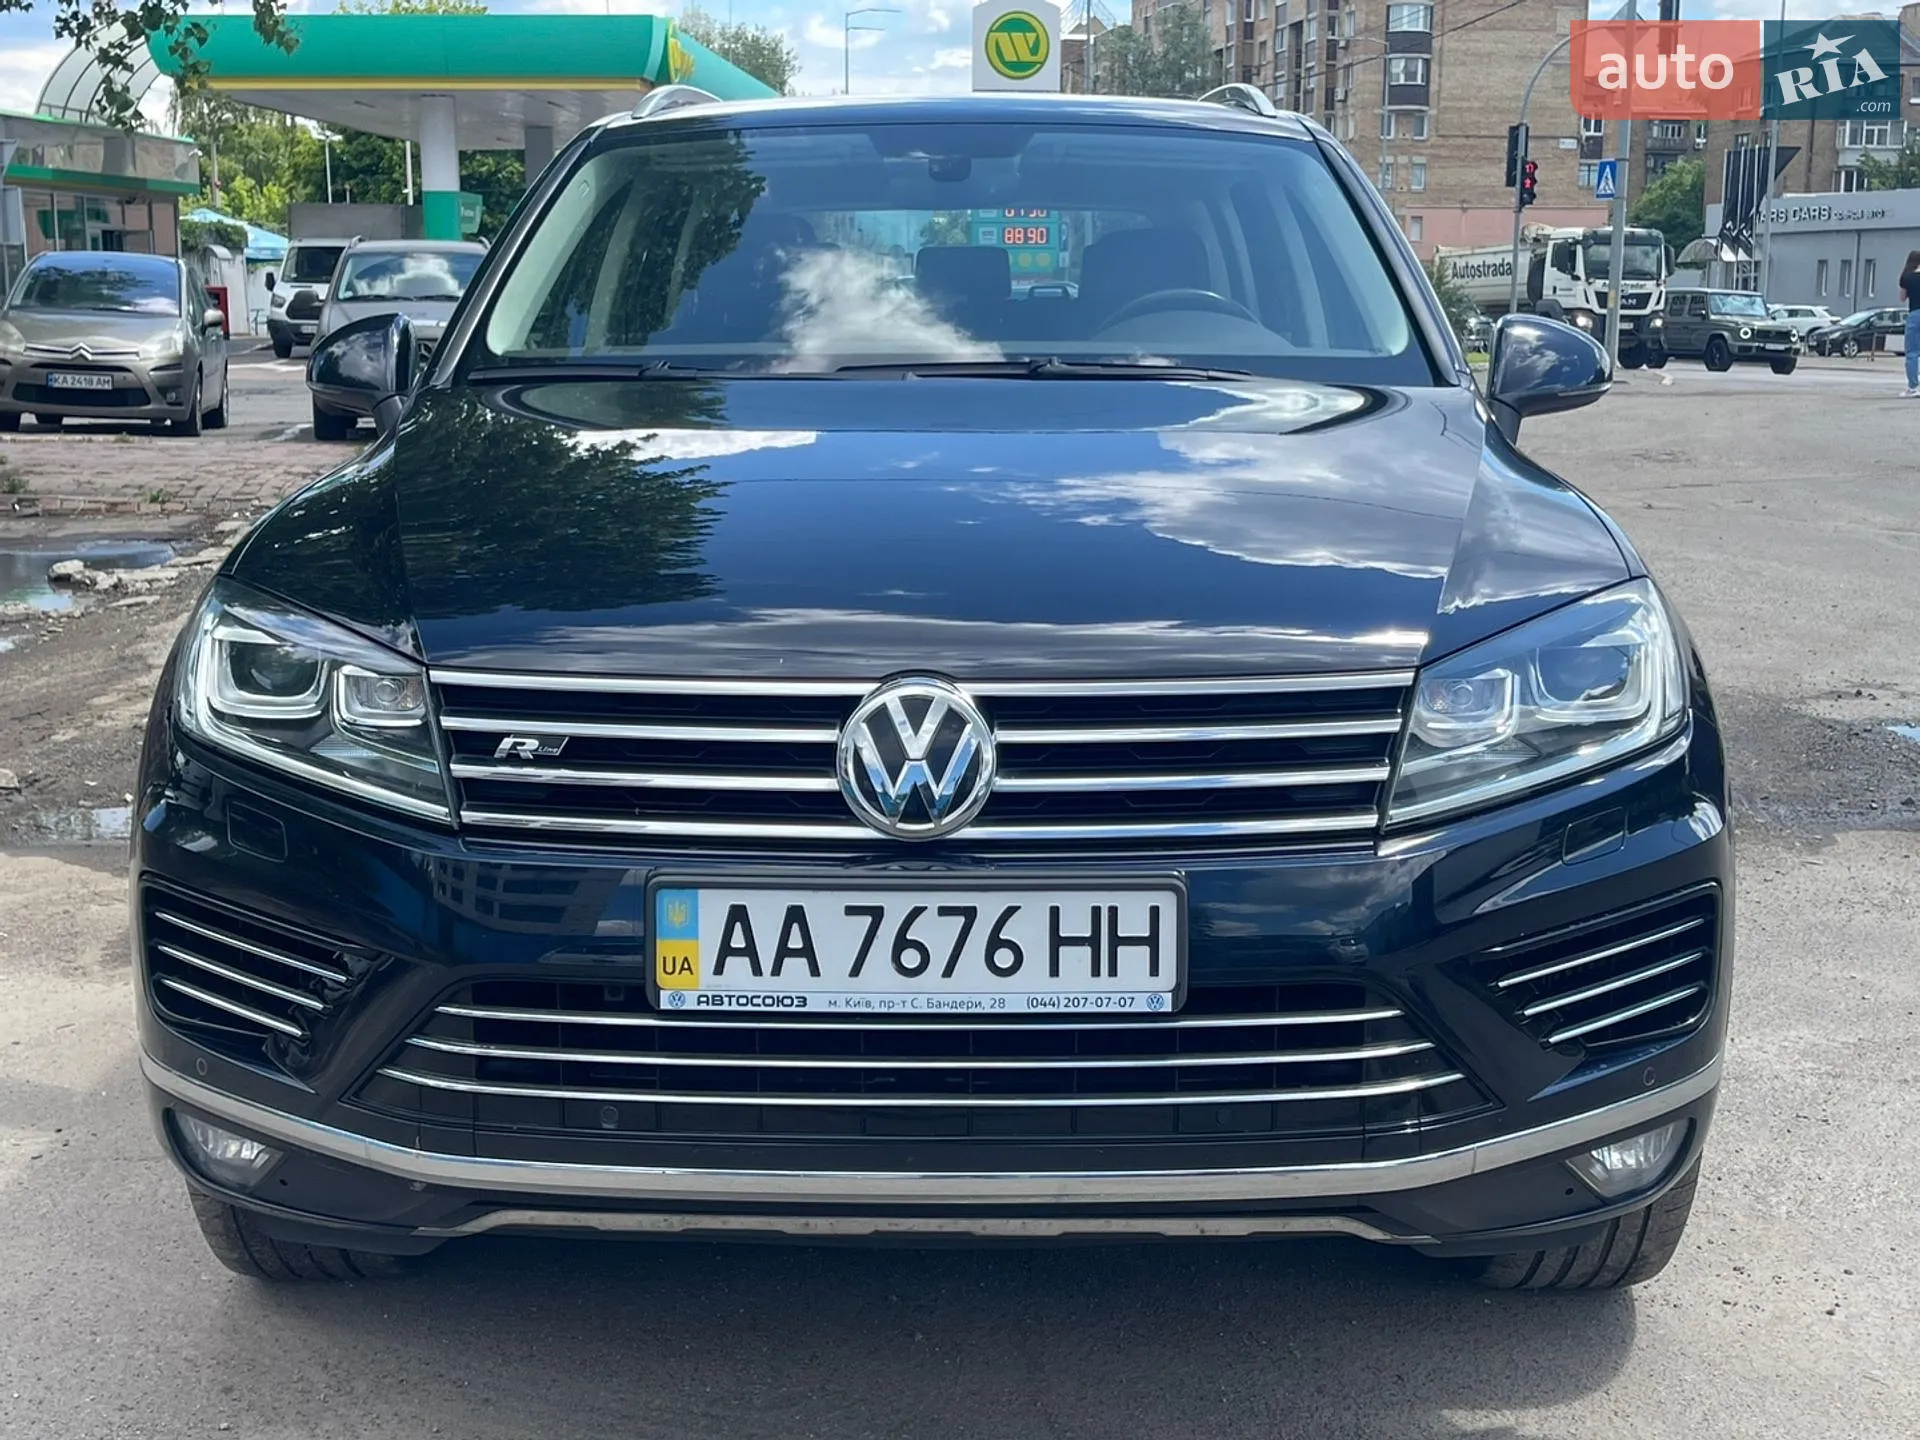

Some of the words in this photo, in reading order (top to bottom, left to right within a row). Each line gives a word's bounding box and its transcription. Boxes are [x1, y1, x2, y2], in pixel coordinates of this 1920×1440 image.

[1791, 205, 1831, 221] CARS
[1452, 257, 1512, 280] Autostrada
[54, 375, 69, 385] KA
[96, 377, 110, 387] AM
[712, 904, 821, 977] AA
[844, 905, 1025, 978] 7676
[1049, 905, 1160, 978] HH
[662, 954, 694, 976] UA
[696, 994, 808, 1008] АВТОСОЮЗ
[828, 999, 840, 1008] м.
[845, 998, 875, 1010] Київ,
[879, 1000, 906, 1010] пр-т
[910, 999, 922, 1009] С.
[926, 998, 985, 1011] Бандери,
[990, 998, 1006, 1009] 28
[1026, 997, 1061, 1010] (044)
[1063, 996, 1136, 1009] 207-07-07
